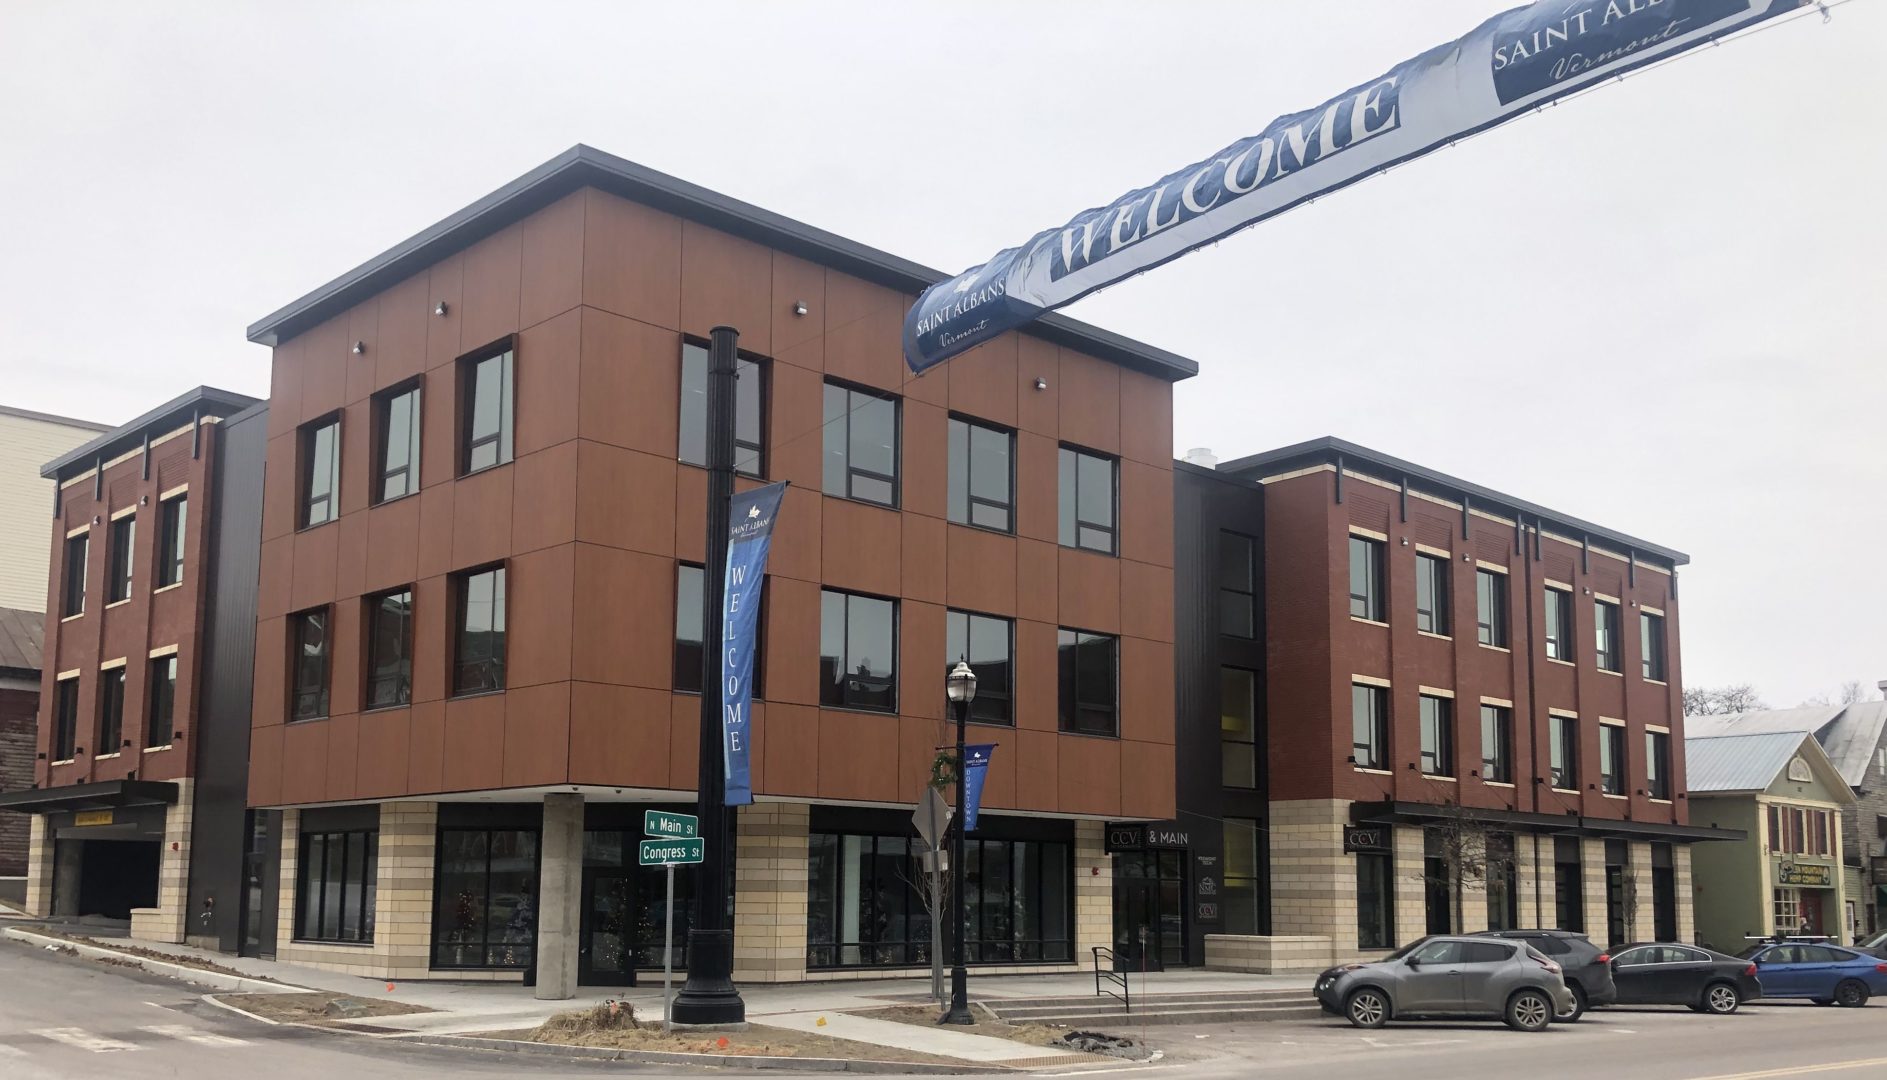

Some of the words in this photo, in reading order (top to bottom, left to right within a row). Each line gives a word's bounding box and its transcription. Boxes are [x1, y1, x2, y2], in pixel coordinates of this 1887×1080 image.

[1494, 9, 1592, 71] SAINT
[1601, 0, 1663, 26] AL
[1549, 17, 1690, 80] Vermont
[1060, 75, 1398, 273] WELCOME
[917, 305, 952, 337] SAINT
[953, 278, 1005, 318] ALBANS
[939, 318, 990, 347] Vermont
[727, 565, 747, 751] WELCOME
[650, 820, 655, 830] N
[660, 817, 682, 833] Main
[686, 824, 693, 835] St
[1110, 831, 1137, 845] CCV
[1149, 830, 1157, 843] &
[1160, 831, 1188, 845] MAIN
[1350, 833, 1377, 845] CCV
[643, 845, 686, 862] Congress
[692, 847, 699, 857] St
